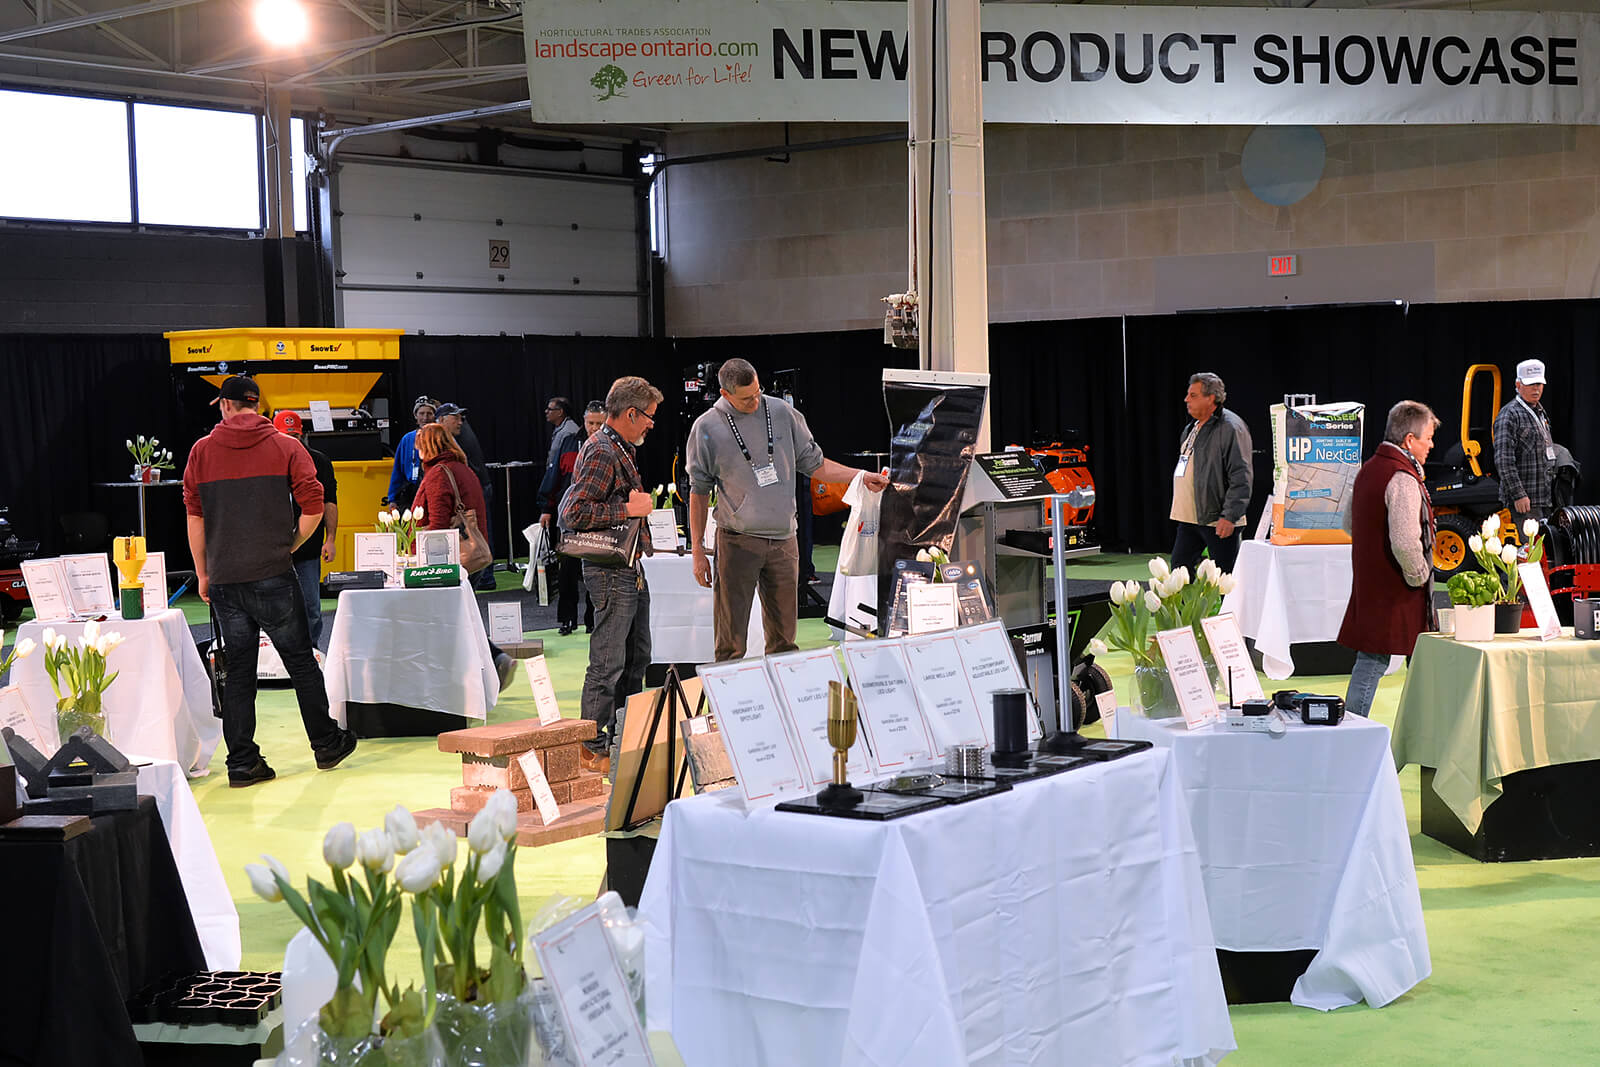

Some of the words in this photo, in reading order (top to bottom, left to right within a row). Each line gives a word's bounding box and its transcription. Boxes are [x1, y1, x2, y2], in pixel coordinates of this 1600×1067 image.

[540, 28, 613, 37] HORTICULTURAL
[616, 28, 650, 36] TRADES
[653, 27, 711, 36] ASSOCIATION
[773, 28, 909, 81] NEW
[982, 31, 1237, 84] RODUCT
[1253, 34, 1579, 87] SHOWCASE
[633, 70, 682, 88] Green
[686, 66, 709, 87] for
[713, 62, 753, 84] Life!
[491, 246, 509, 263] 29
[1272, 256, 1293, 275] EXIT
[1310, 422, 1353, 430] ProSeries
[1288, 437, 1312, 461] HP
[410, 569, 428, 577] RAIN
[435, 567, 453, 576] BIRD
